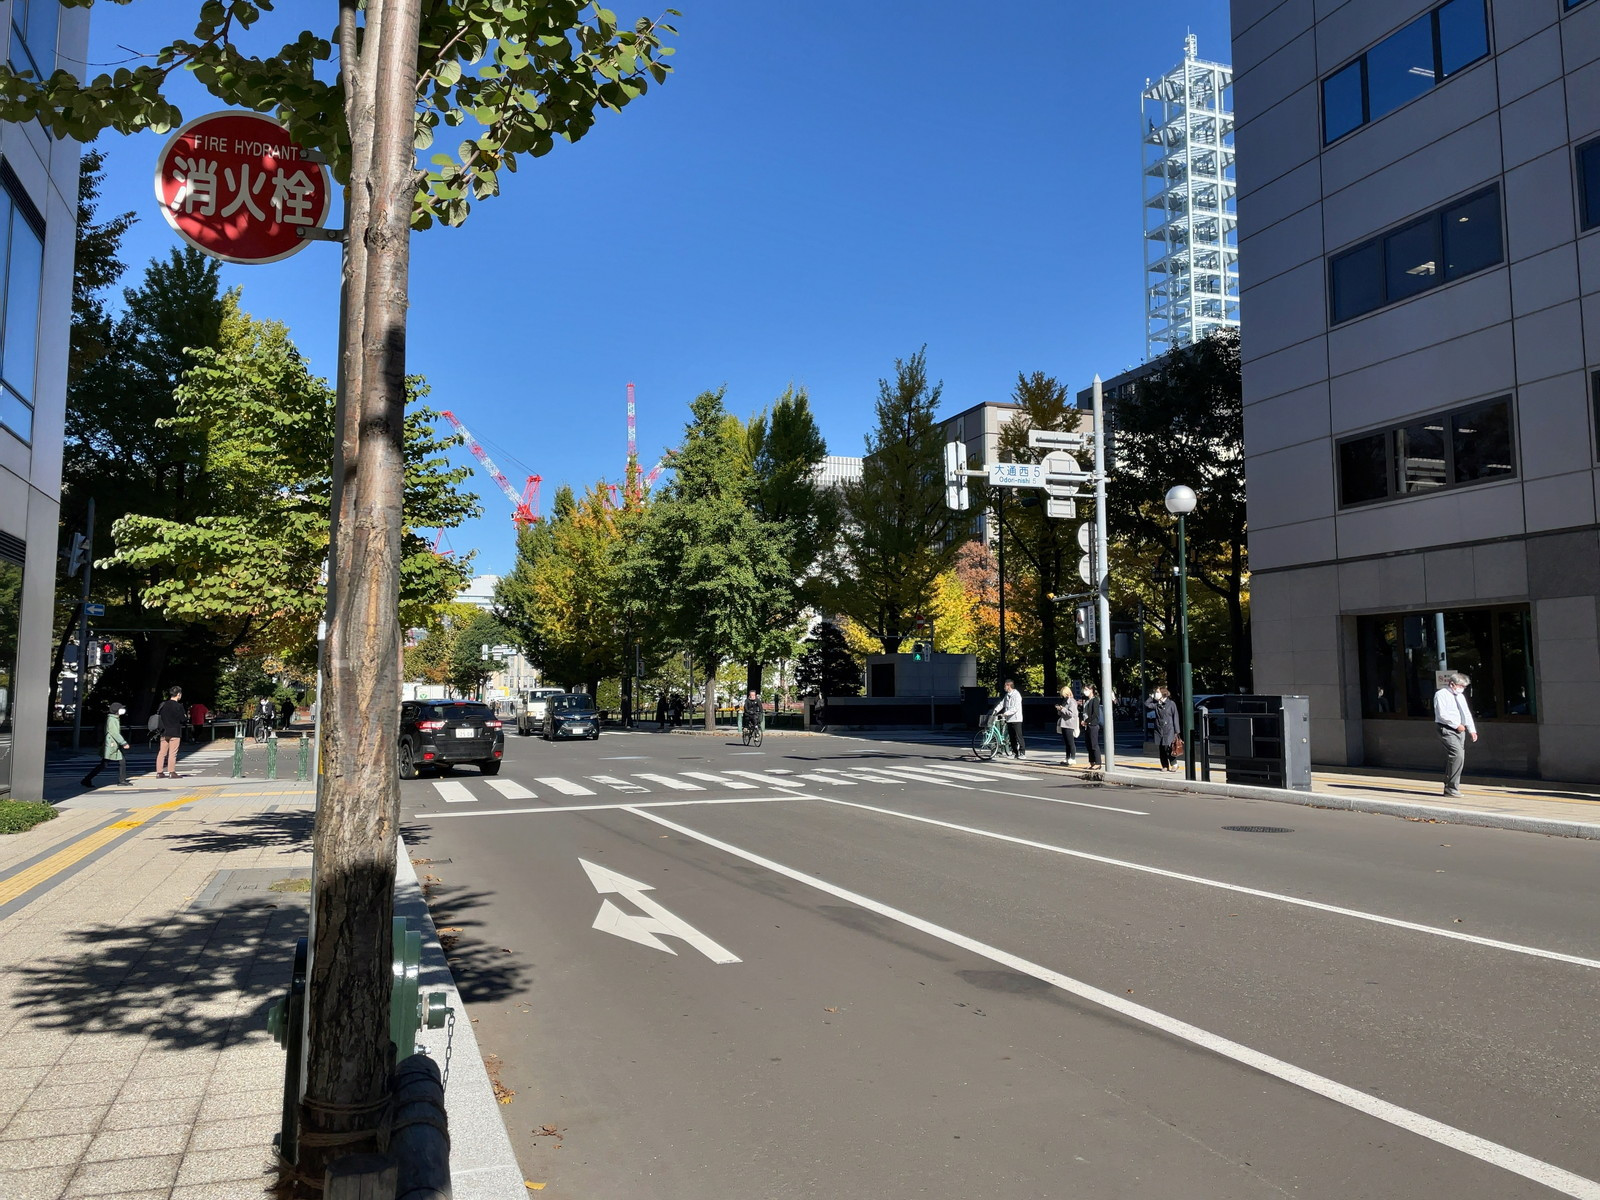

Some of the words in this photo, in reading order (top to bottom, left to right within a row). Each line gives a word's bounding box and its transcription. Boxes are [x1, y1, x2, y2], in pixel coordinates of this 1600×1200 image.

[194, 135, 228, 153] FIRE
[235, 140, 298, 161] HYDRANT
[170, 156, 315, 225] 消火栓
[995, 465, 1029, 477] 大通西
